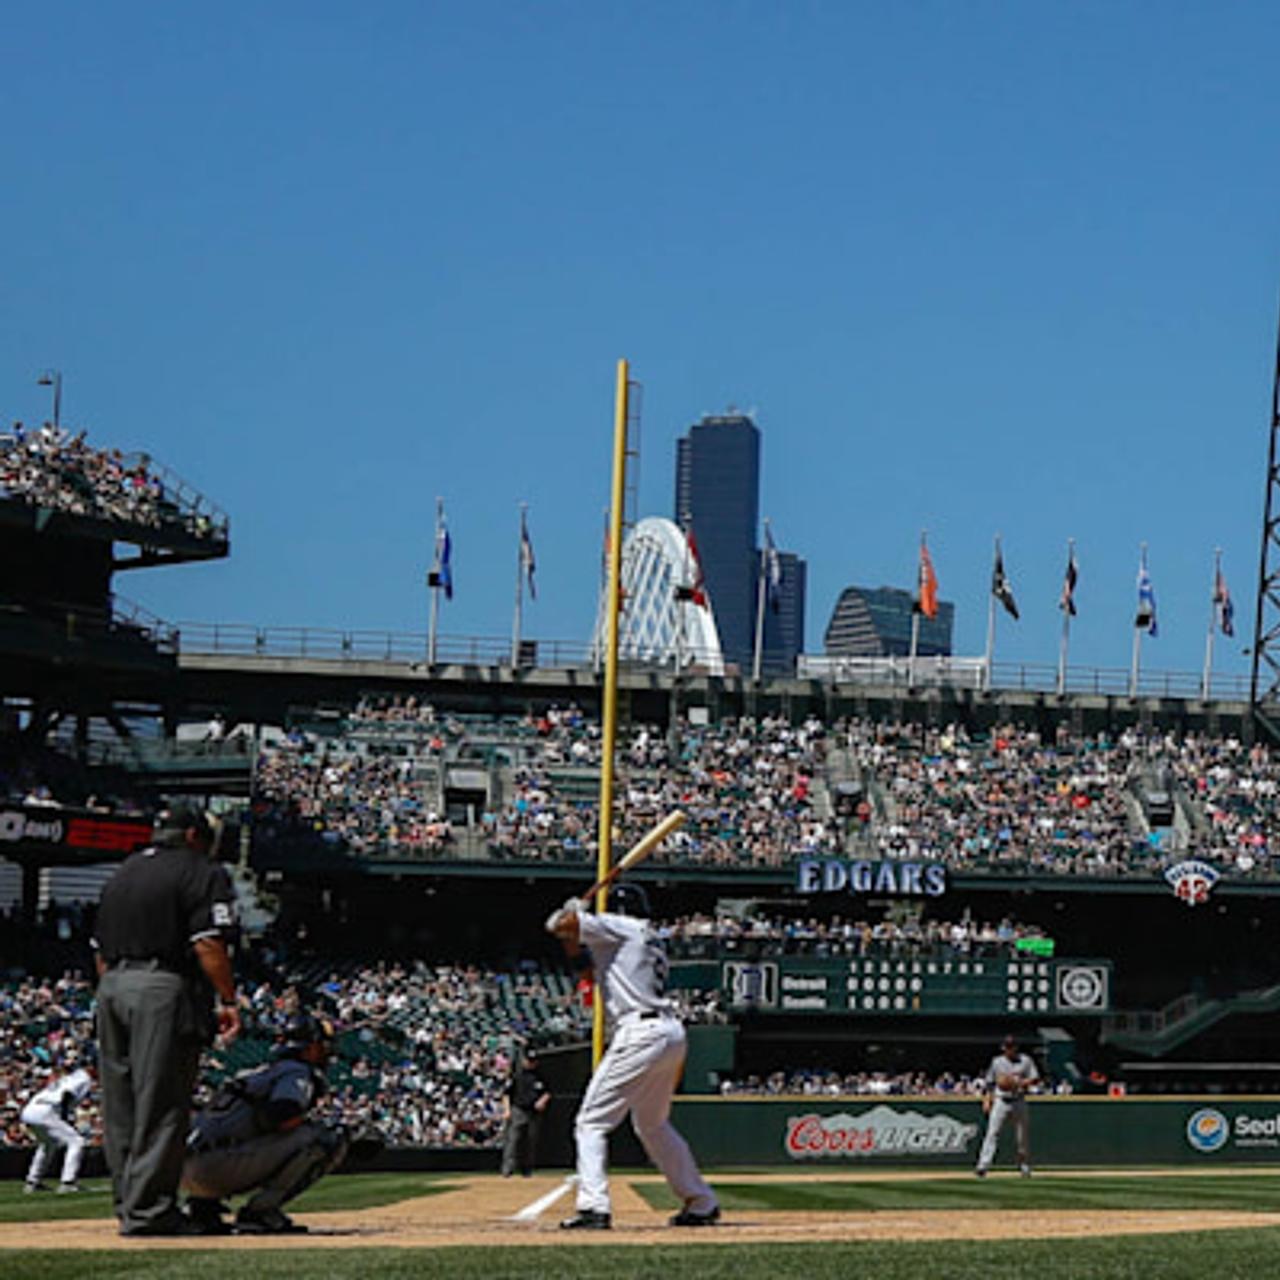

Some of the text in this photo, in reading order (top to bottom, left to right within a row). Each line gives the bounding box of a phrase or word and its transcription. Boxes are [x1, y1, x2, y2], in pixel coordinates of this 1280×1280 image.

[798, 860, 946, 896] EDGARS
[1177, 878, 1209, 902] 42
[788, 1115, 977, 1154] Coors LIGHT
